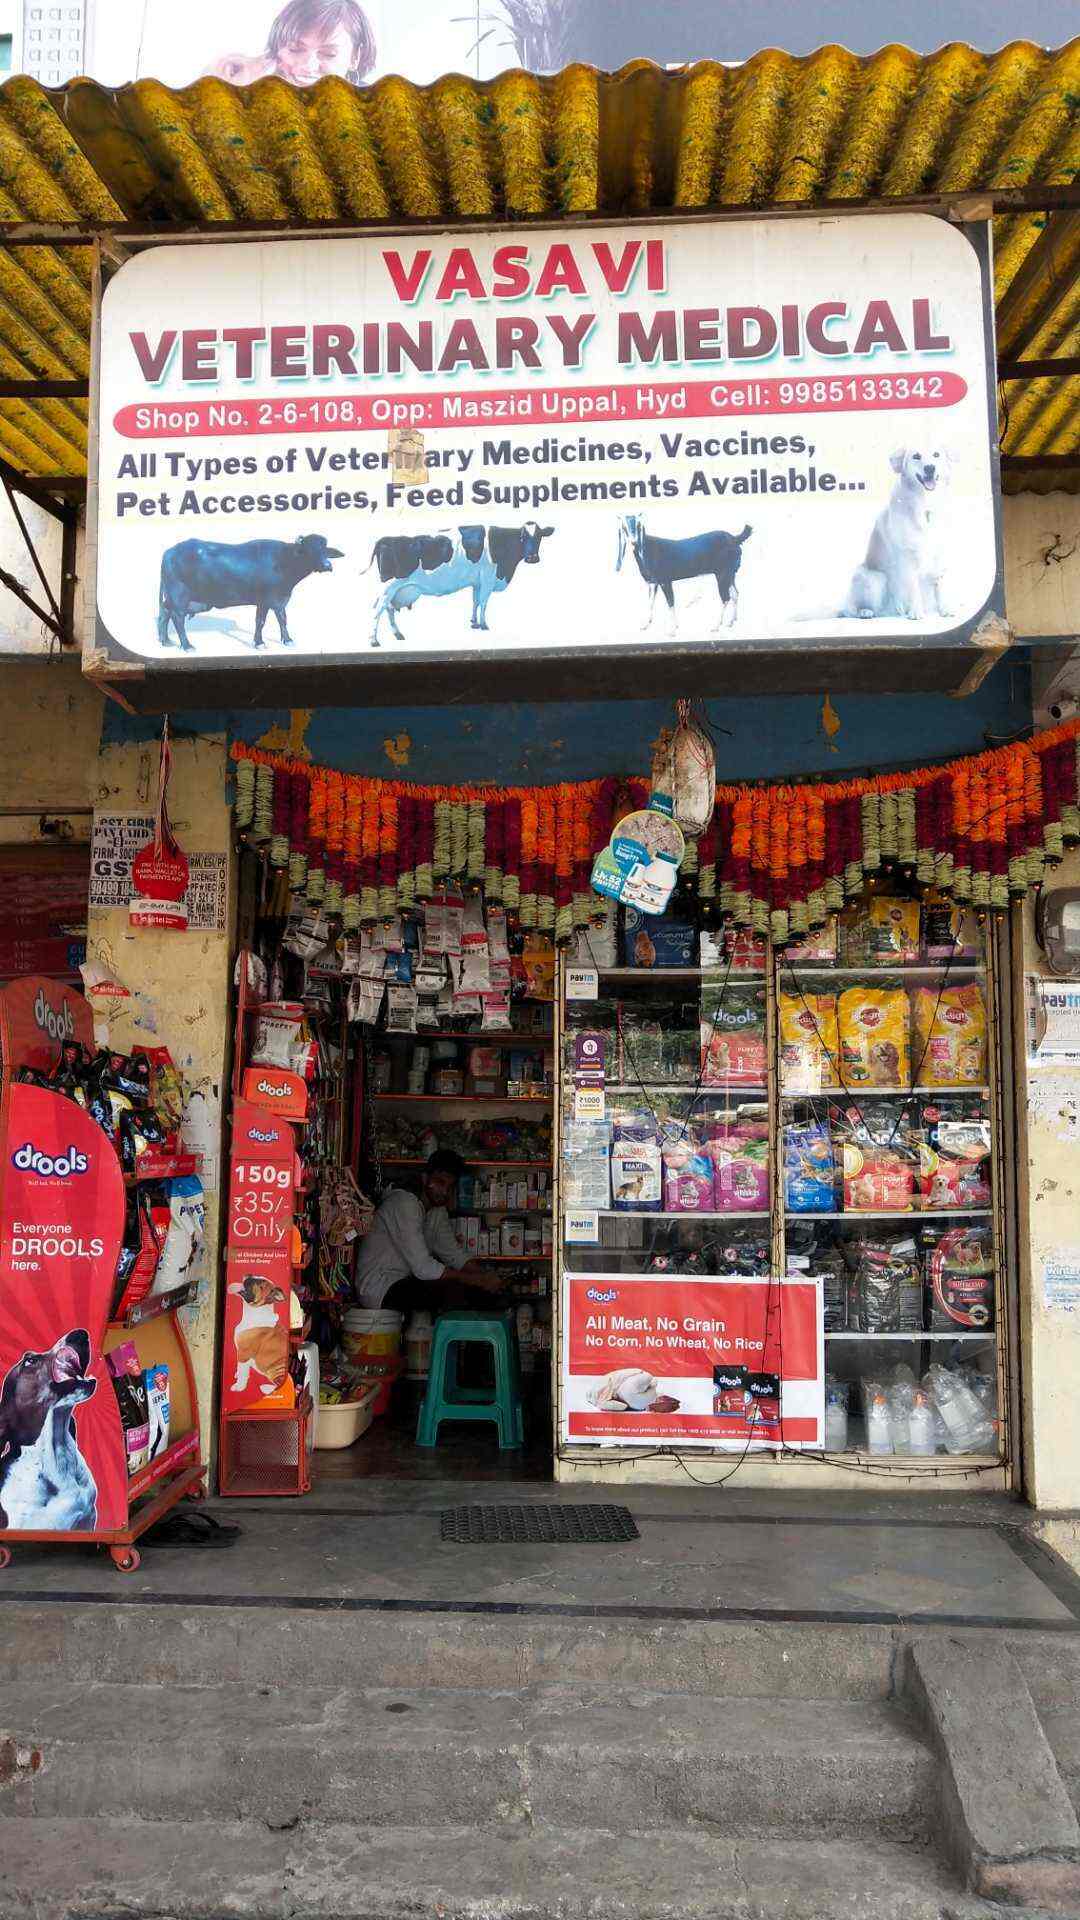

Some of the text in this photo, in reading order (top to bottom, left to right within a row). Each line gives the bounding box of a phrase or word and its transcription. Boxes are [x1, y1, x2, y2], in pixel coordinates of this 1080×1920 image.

[382, 240, 664, 302] VASAVI
[129, 299, 950, 383] VETERINARY MEDICAL
[135, 377, 943, 432] Shop No. 2-6-108, Opp: Maszid Uppal, Hyd Cell: 9985133342
[117, 431, 816, 481] All Types of Veterary Medicines, Vaccines,
[116, 468, 866, 517] Pet Accessories, Feed Supplements Available...
[90, 896, 130, 905] PASSPO
[34, 989, 74, 1041] drools
[713, 1009, 757, 1024] drools
[258, 1080, 292, 1097] drools
[248, 1128, 280, 1142] drools
[14, 1144, 88, 1176] drools
[235, 1165, 291, 1188] 150g
[233, 1191, 289, 1213] ₹35/-
[13, 1222, 72, 1236] Everyone
[233, 1217, 286, 1243] Only
[12, 1238, 104, 1257] DROOLS
[11, 1259, 41, 1271] here.
[587, 1287, 618, 1301] drools
[586, 1316, 726, 1332] All Meat, No Grain
[586, 1335, 764, 1351] No Corn, No Wheat, No Rice
[720, 1375, 741, 1386] drools
